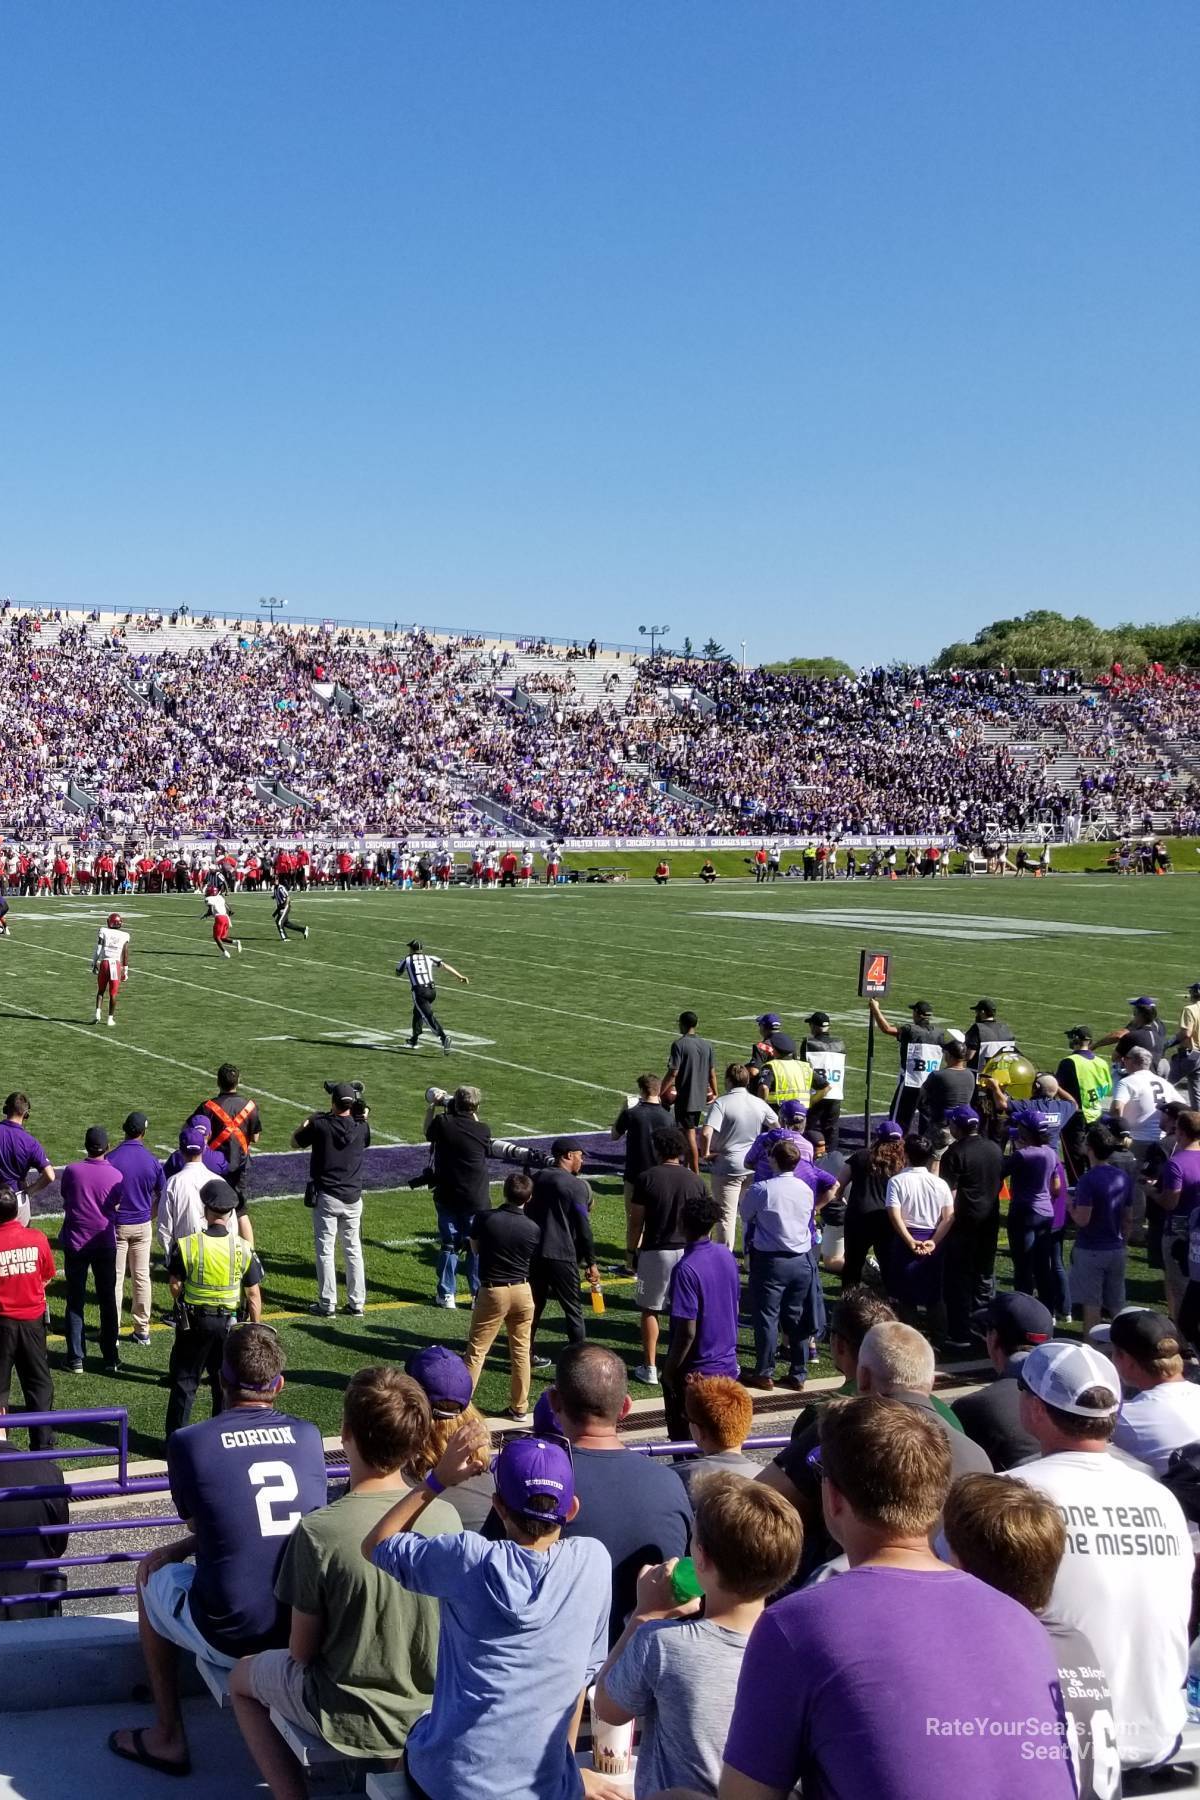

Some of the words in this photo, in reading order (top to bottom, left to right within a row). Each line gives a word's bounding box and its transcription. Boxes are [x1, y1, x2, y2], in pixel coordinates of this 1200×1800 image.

[413, 960, 428, 974] H
[867, 956, 886, 985] 4
[0, 1261, 37, 1277] EMS
[221, 1426, 297, 1449] GORDON
[248, 1460, 302, 1536] 2
